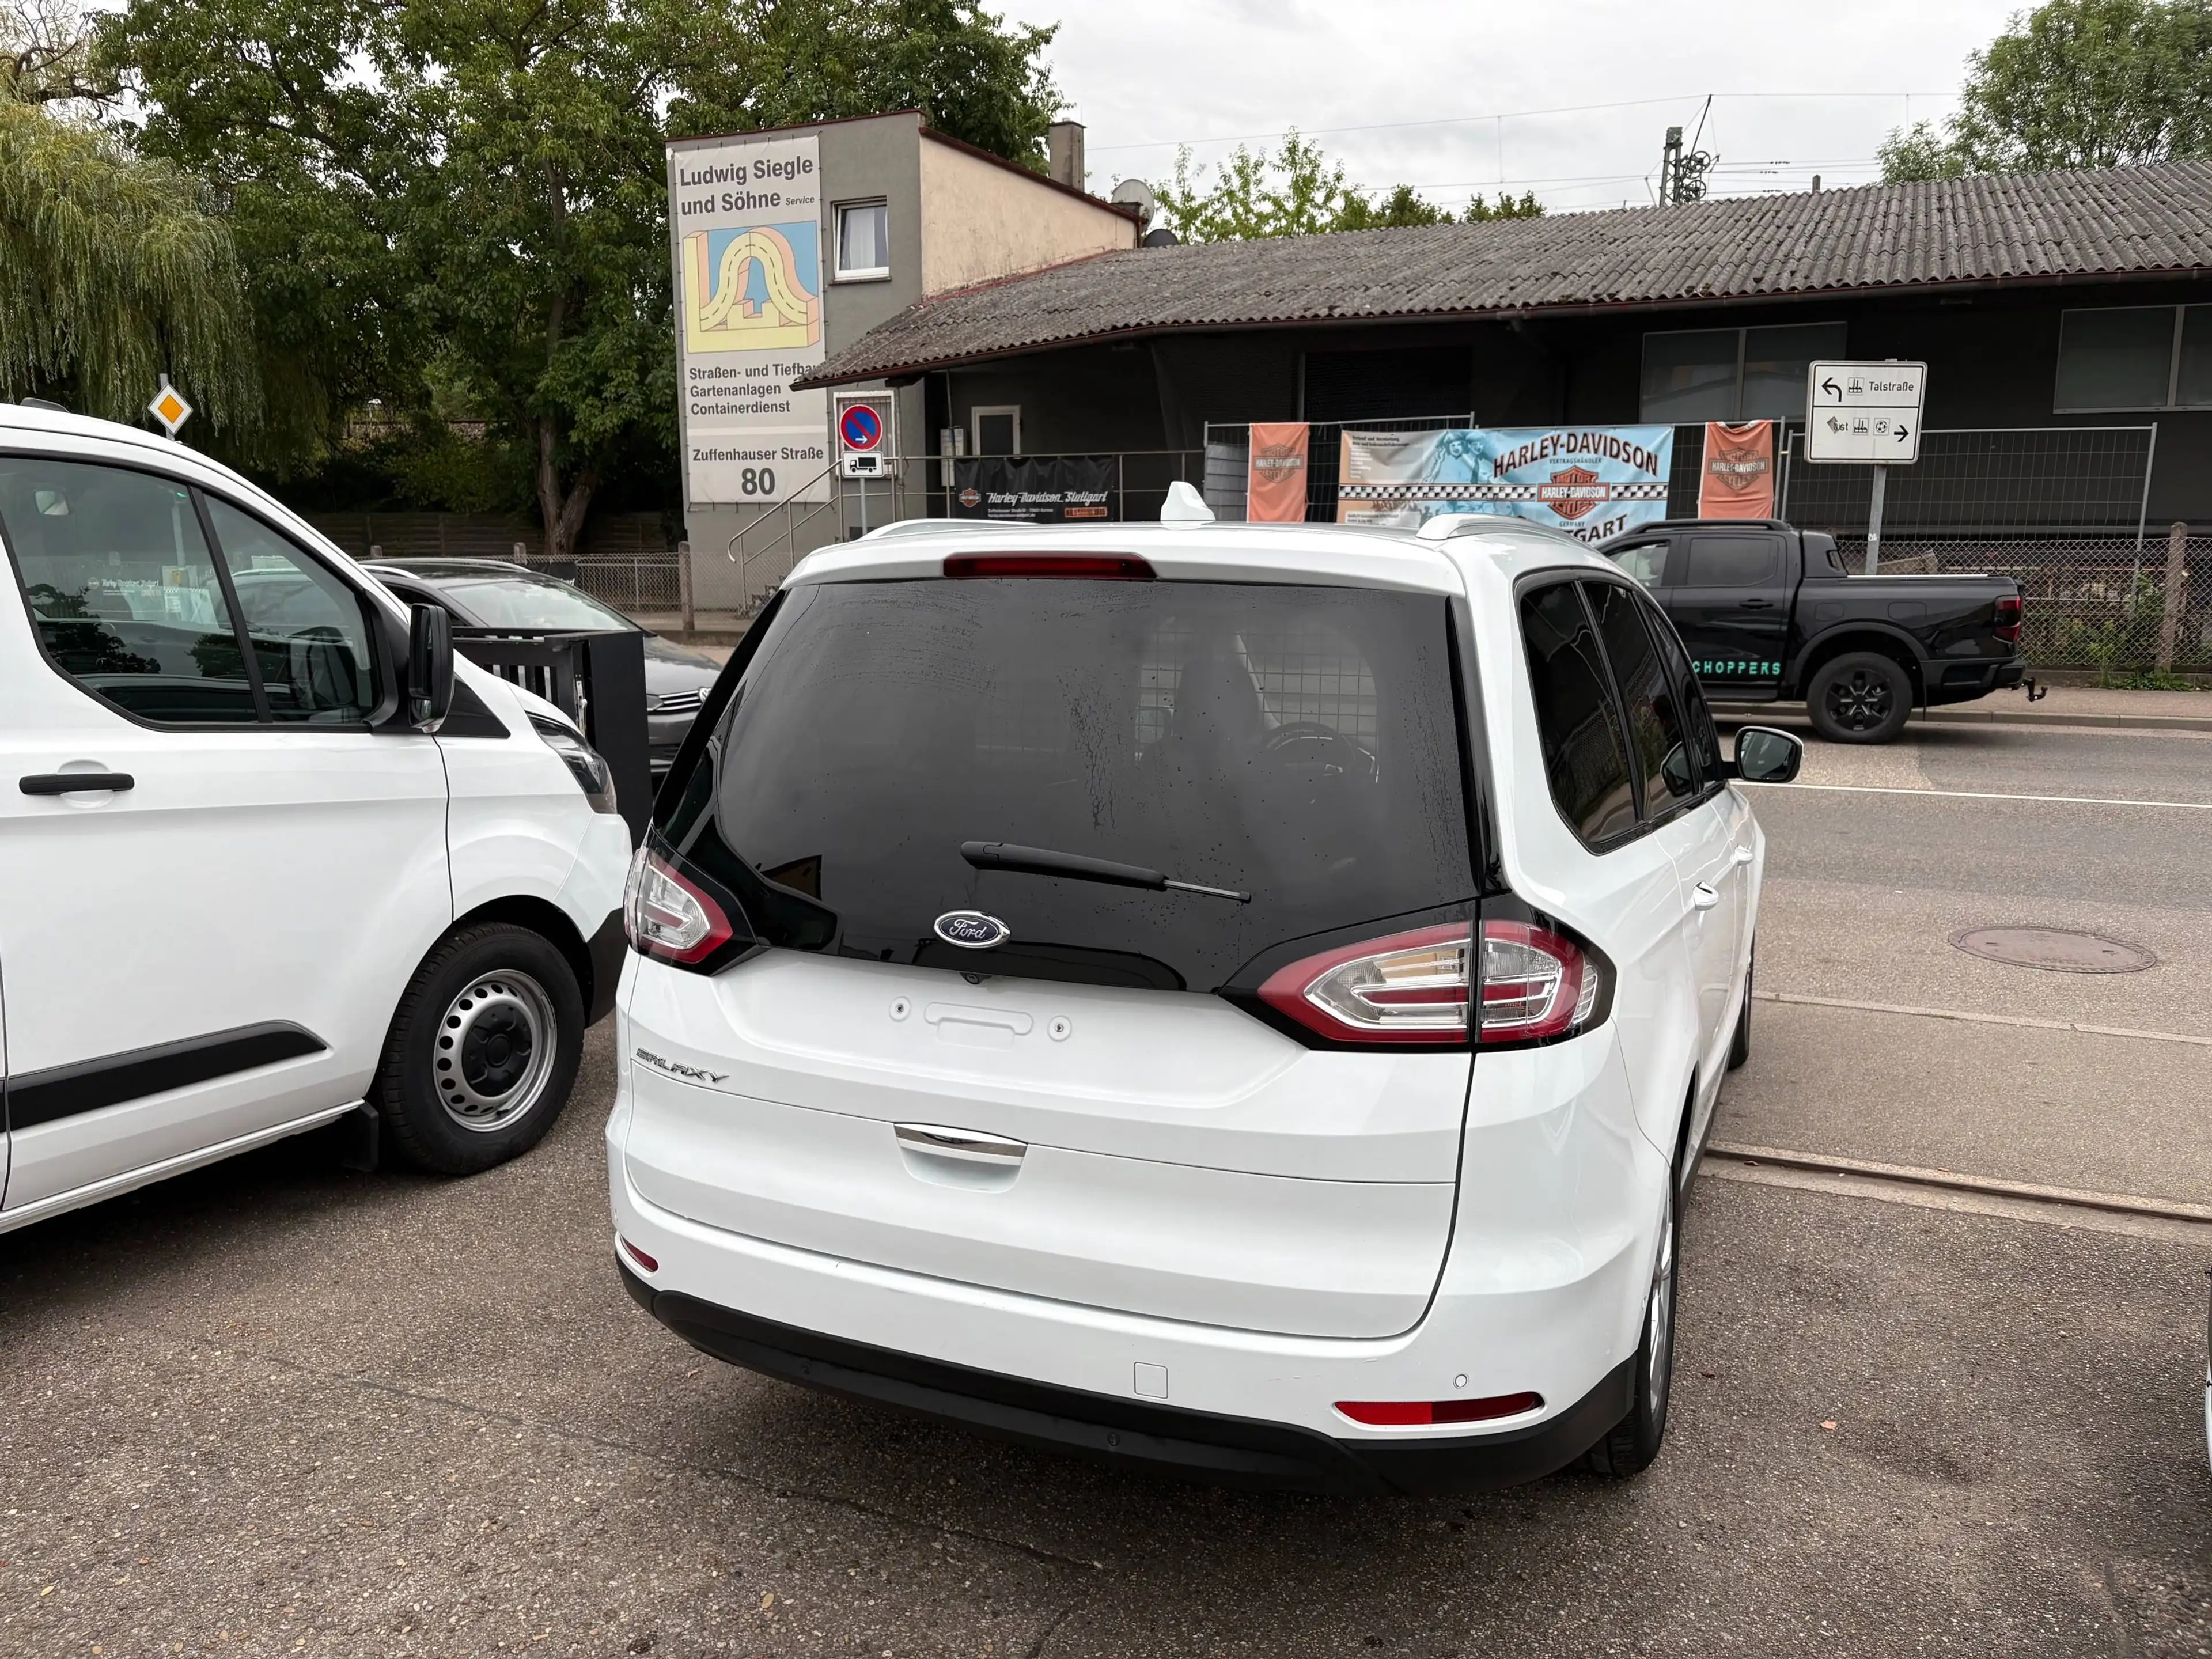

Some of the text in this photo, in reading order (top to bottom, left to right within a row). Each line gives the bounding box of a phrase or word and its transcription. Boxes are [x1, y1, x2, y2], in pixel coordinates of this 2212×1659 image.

[680, 156, 813, 186] Ludwig Siegle
[681, 191, 815, 215] und Söhne Service
[690, 366, 741, 380] Straßen-
[745, 365, 769, 377] und
[690, 383, 781, 398] Gartenanlagen
[1869, 381, 1914, 392] Talstraße
[691, 400, 791, 415] Containerdienst
[692, 446, 824, 461] Zuffenhauser Straße
[1493, 431, 1658, 478] HARLEY-DAVIDSON
[1711, 460, 1766, 473] HARLEY-DAVIDSON
[741, 467, 775, 495] 80
[986, 491, 1108, 507] Harley-Davidson Stuttgart
[1541, 486, 1606, 499] HARLEY-DAVIDSON
[1692, 661, 1781, 675] CHOPPERS
[949, 918, 987, 939] Ford
[635, 1047, 730, 1083] GALAXY
